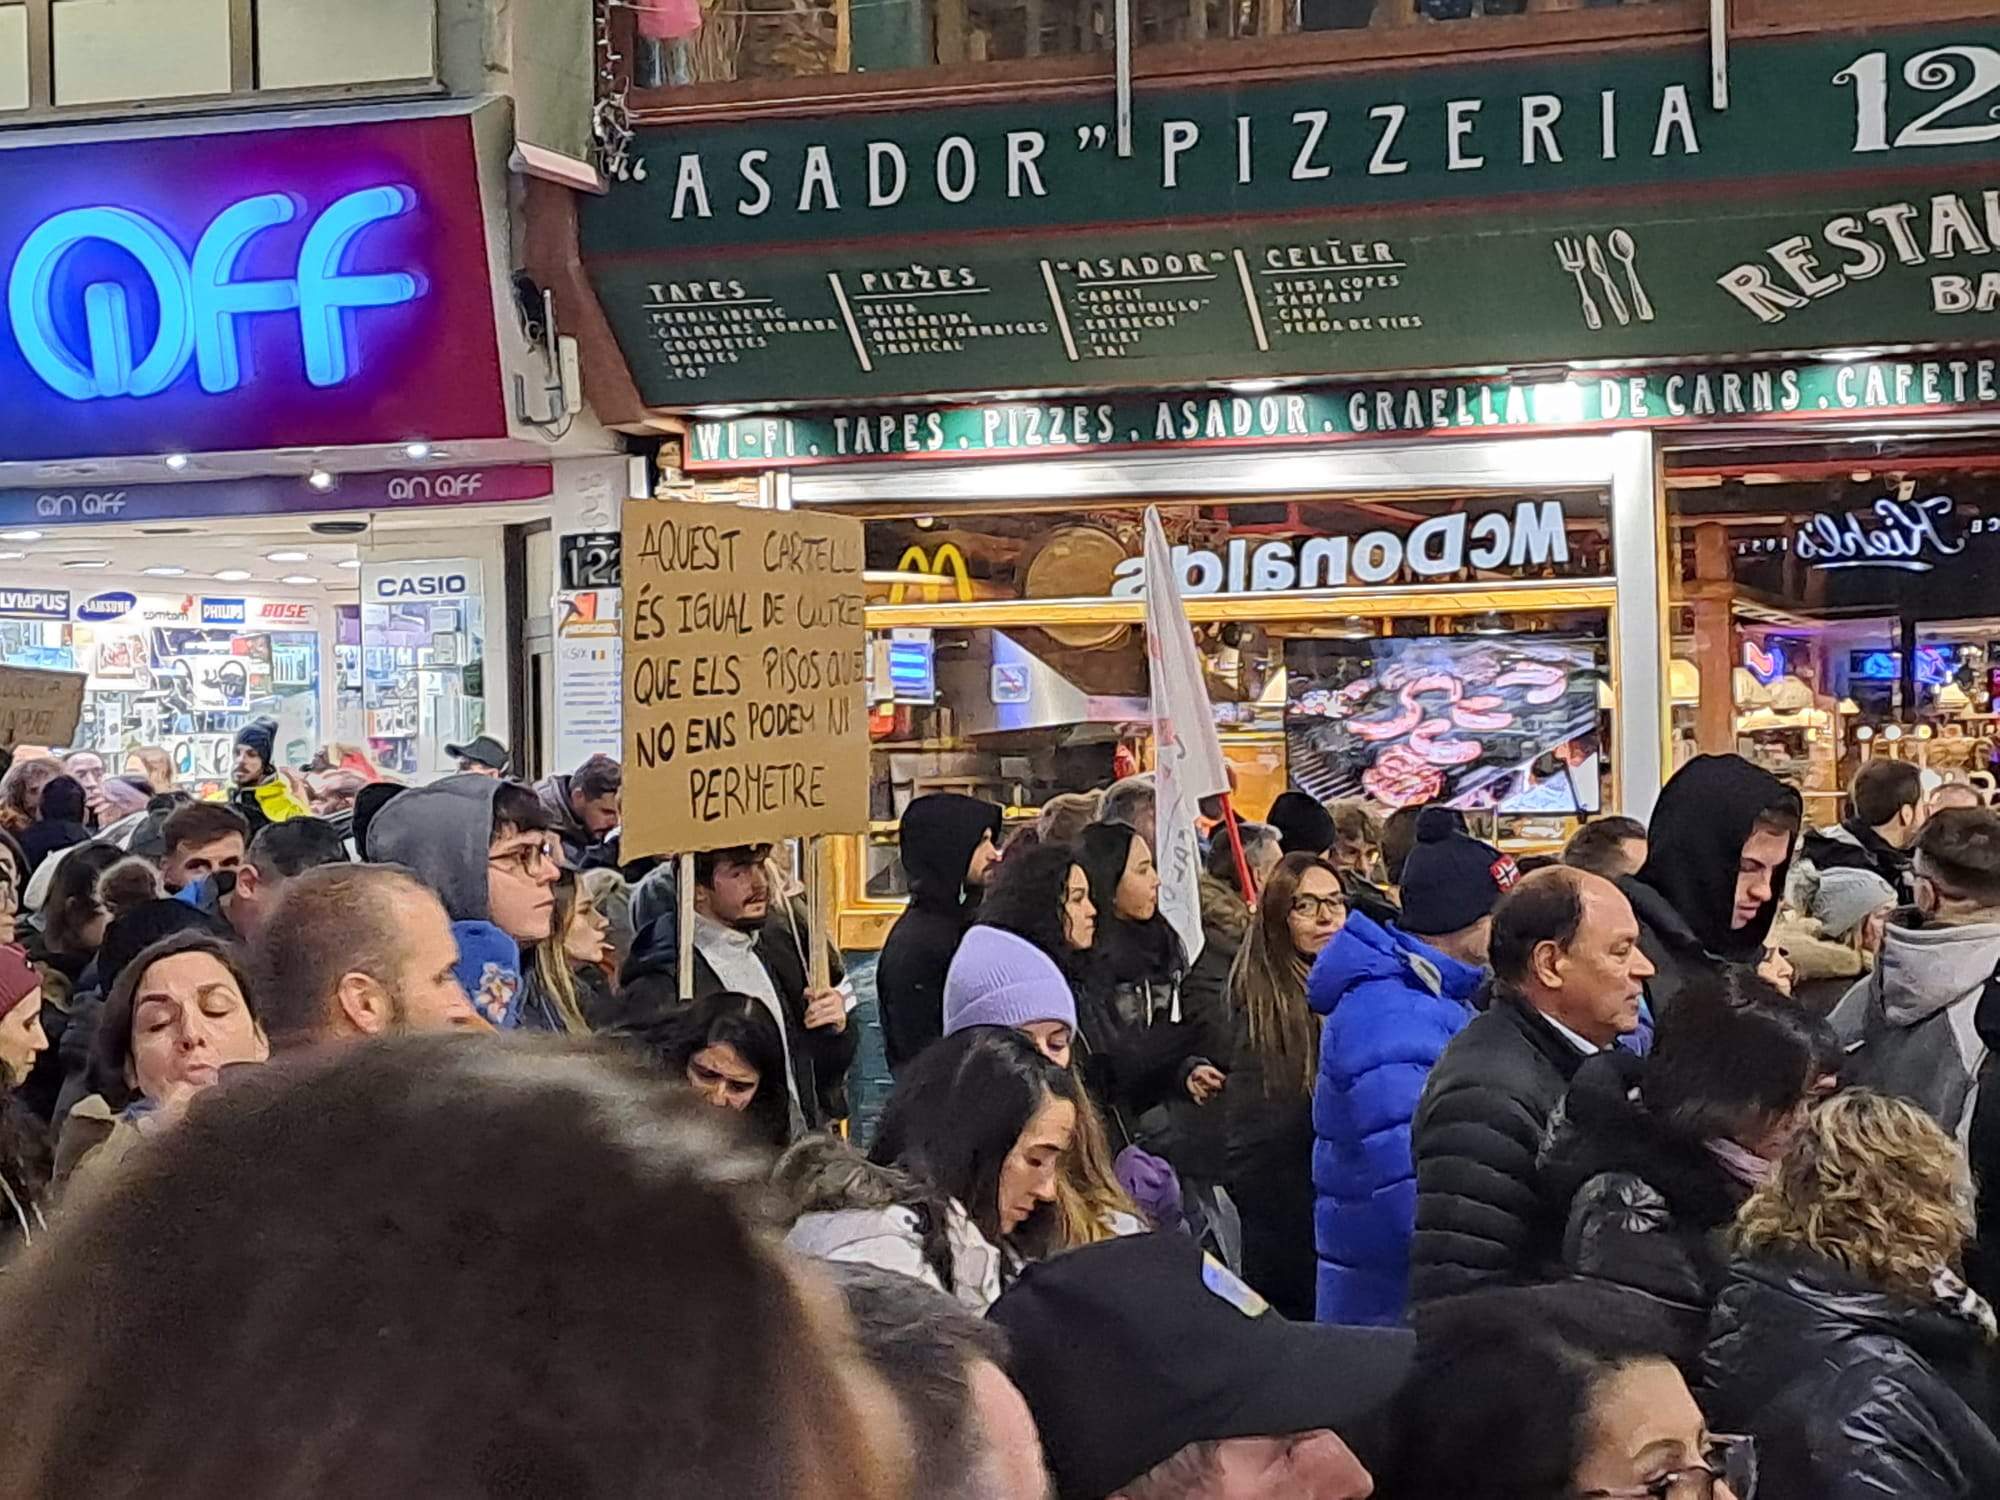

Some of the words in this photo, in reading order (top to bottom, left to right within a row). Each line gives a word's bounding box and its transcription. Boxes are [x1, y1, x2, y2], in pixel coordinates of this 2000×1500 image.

[1161, 85, 1699, 188] PIZZERIA
[648, 280, 746, 302] TAPES
[861, 265, 977, 291] PIZZES
[833, 411, 945, 456] TAPES
[983, 404, 1116, 448] PIZZES
[1155, 394, 1309, 440] ASADOR
[1602, 376, 1649, 418] DE
[1665, 367, 1800, 417] CARNS
[638, 520, 741, 573] AQUEST
[261, 603, 309, 618] BOSE
[377, 574, 466, 597] CASIO
[633, 583, 666, 641] ÉS
[677, 592, 753, 638] IGUAL
[763, 592, 786, 627] DE
[634, 657, 682, 707] QUE
[693, 654, 741, 697] ELS
[762, 646, 821, 695] PISOS
[636, 720, 676, 769] NO
[686, 711, 737, 755] ENS
[748, 701, 815, 742] PODEM
[828, 696, 851, 737] NI
[690, 763, 827, 822] PERMETRE
